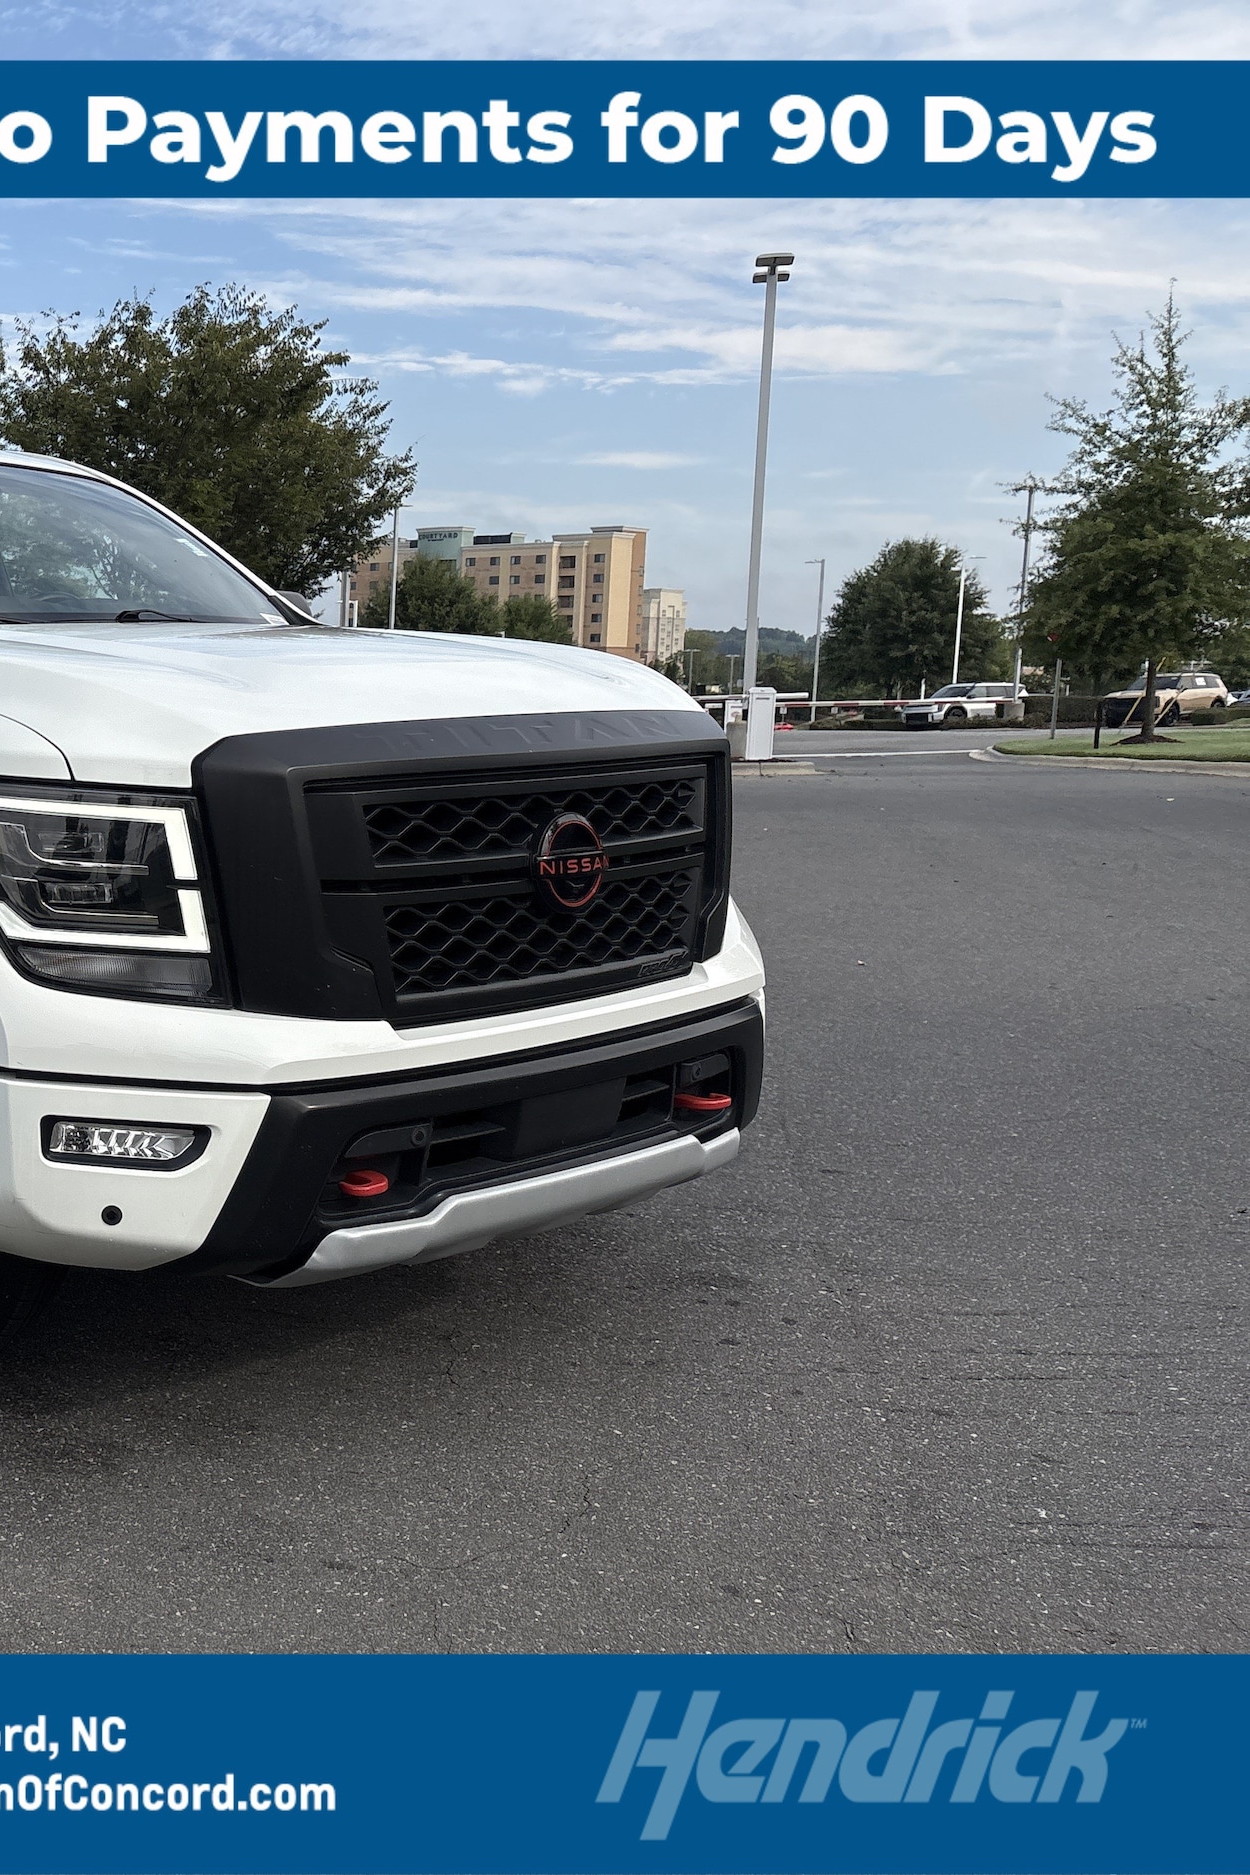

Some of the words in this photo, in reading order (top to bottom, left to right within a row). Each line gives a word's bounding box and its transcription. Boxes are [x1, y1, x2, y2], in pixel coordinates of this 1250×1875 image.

[419, 532, 458, 540] COURTYARD
[354, 714, 682, 751] TITAN
[539, 855, 610, 875] NISSAN
